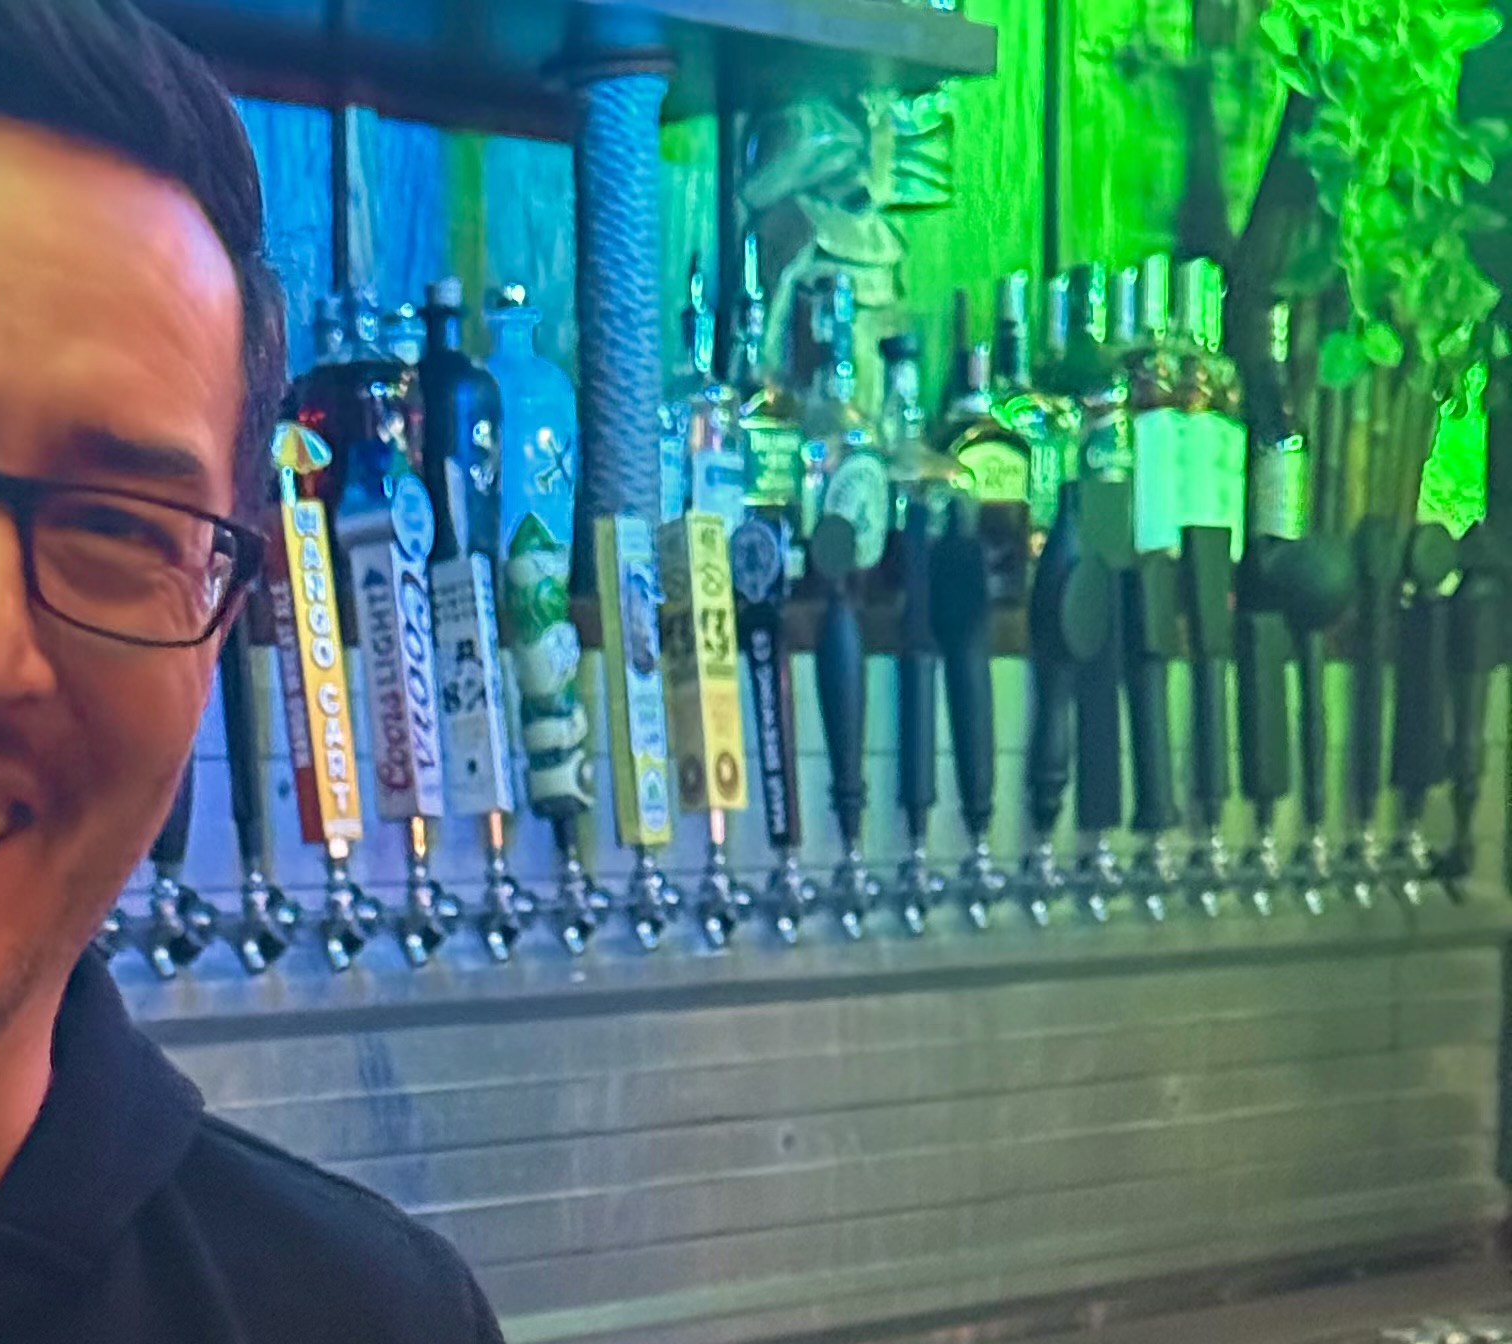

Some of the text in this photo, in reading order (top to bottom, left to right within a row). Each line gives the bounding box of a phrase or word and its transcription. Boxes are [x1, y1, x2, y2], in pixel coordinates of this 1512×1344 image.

[293, 501, 351, 813] MANGO CART
[364, 586, 395, 686] LIGHT
